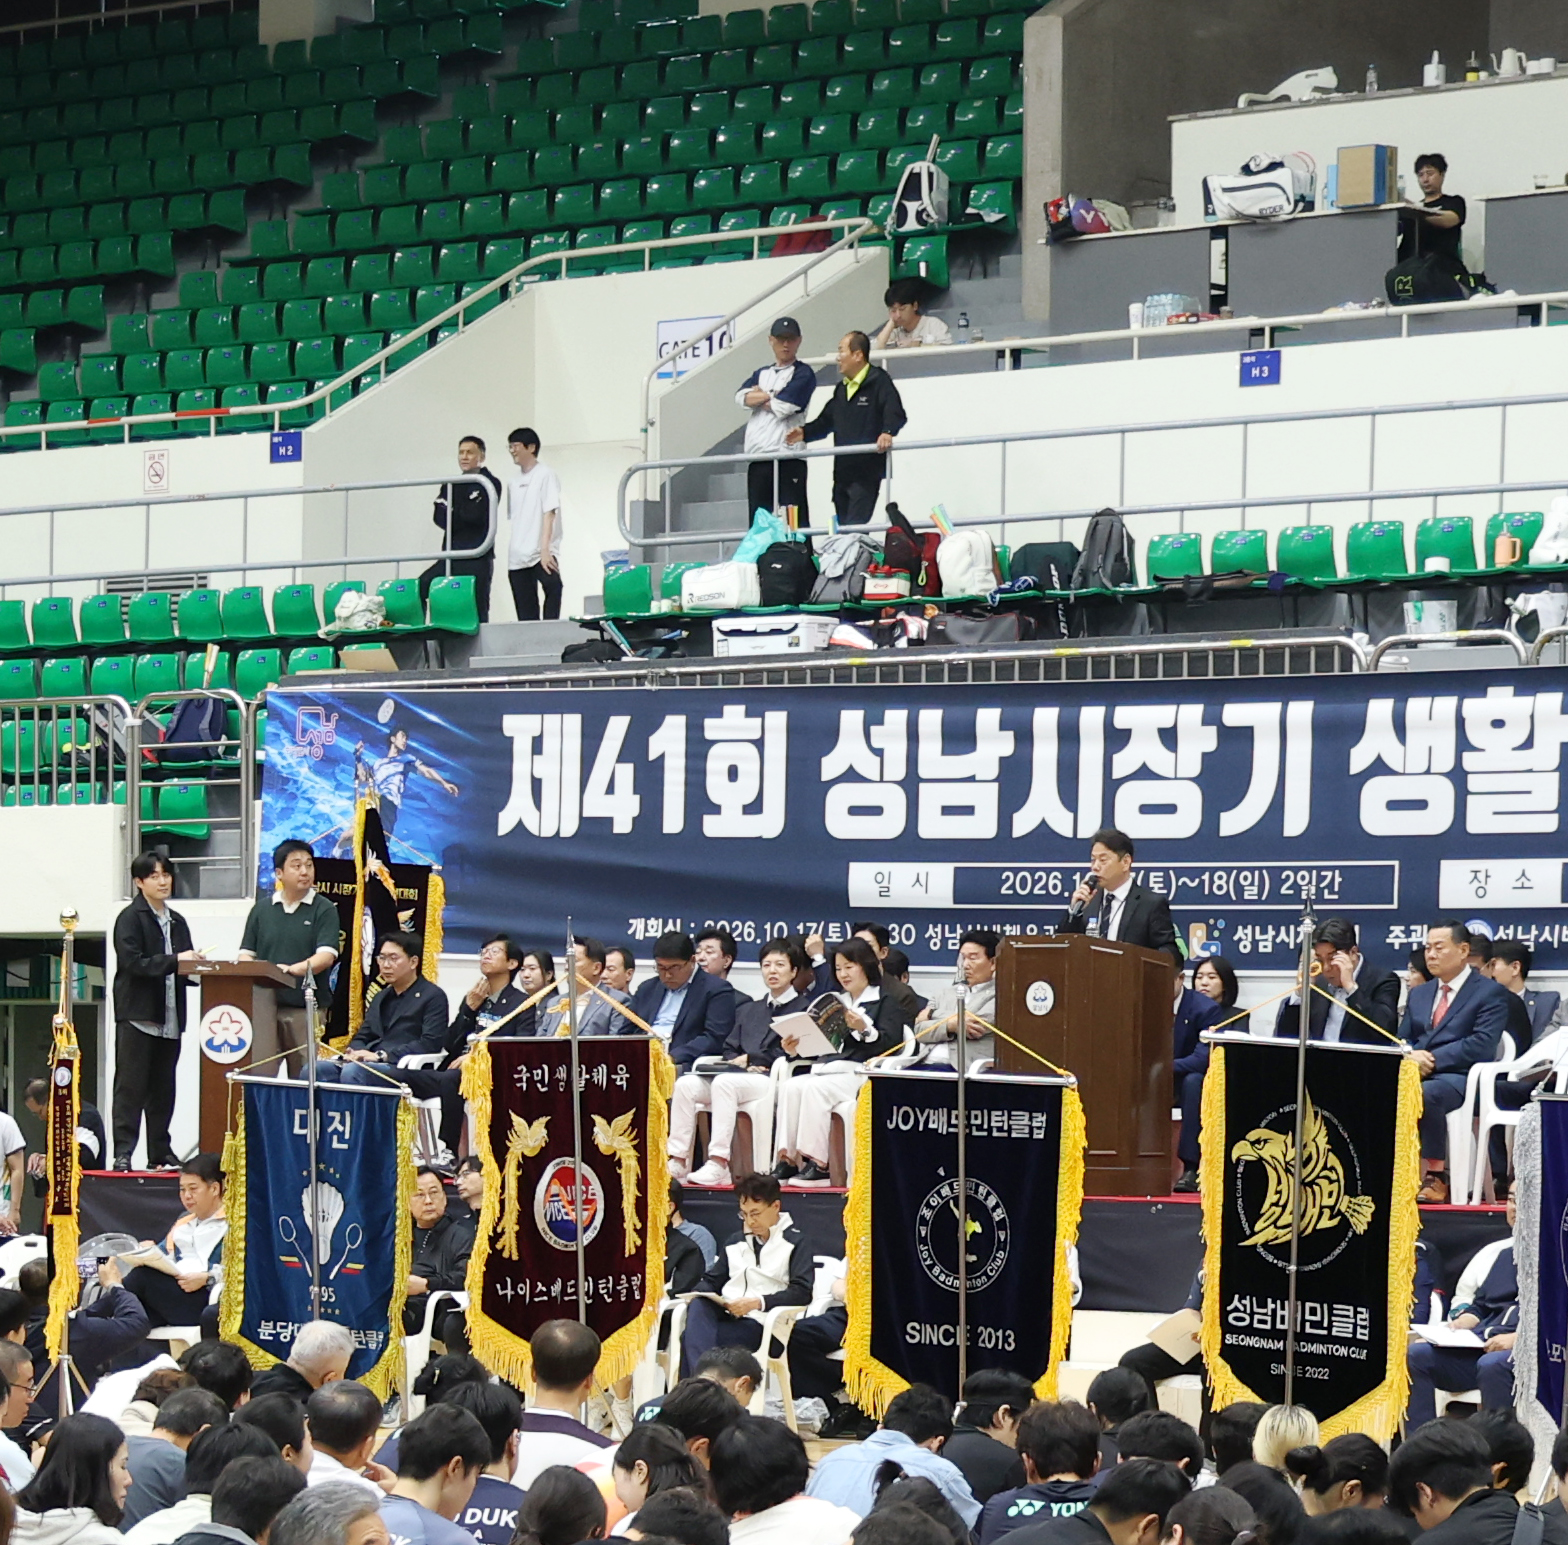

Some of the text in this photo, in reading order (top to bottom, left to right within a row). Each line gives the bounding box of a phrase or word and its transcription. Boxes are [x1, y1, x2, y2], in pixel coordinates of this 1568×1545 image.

[1258, 205, 1285, 216] RYDER
[1261, 366, 1269, 377] 3
[286, 445, 293, 455] 2
[498, 705, 788, 839] 제41회
[820, 700, 1314, 840] 성남시장기
[1280, 869, 1343, 899] 2일간
[987, 1250, 1005, 1276] Club
[1226, 1294, 1370, 1341] 성남배민클럽
[978, 1325, 1016, 1351] 2013
[1225, 1333, 1284, 1351] SEONGNAM
[1304, 1366, 1330, 1380] 2022
